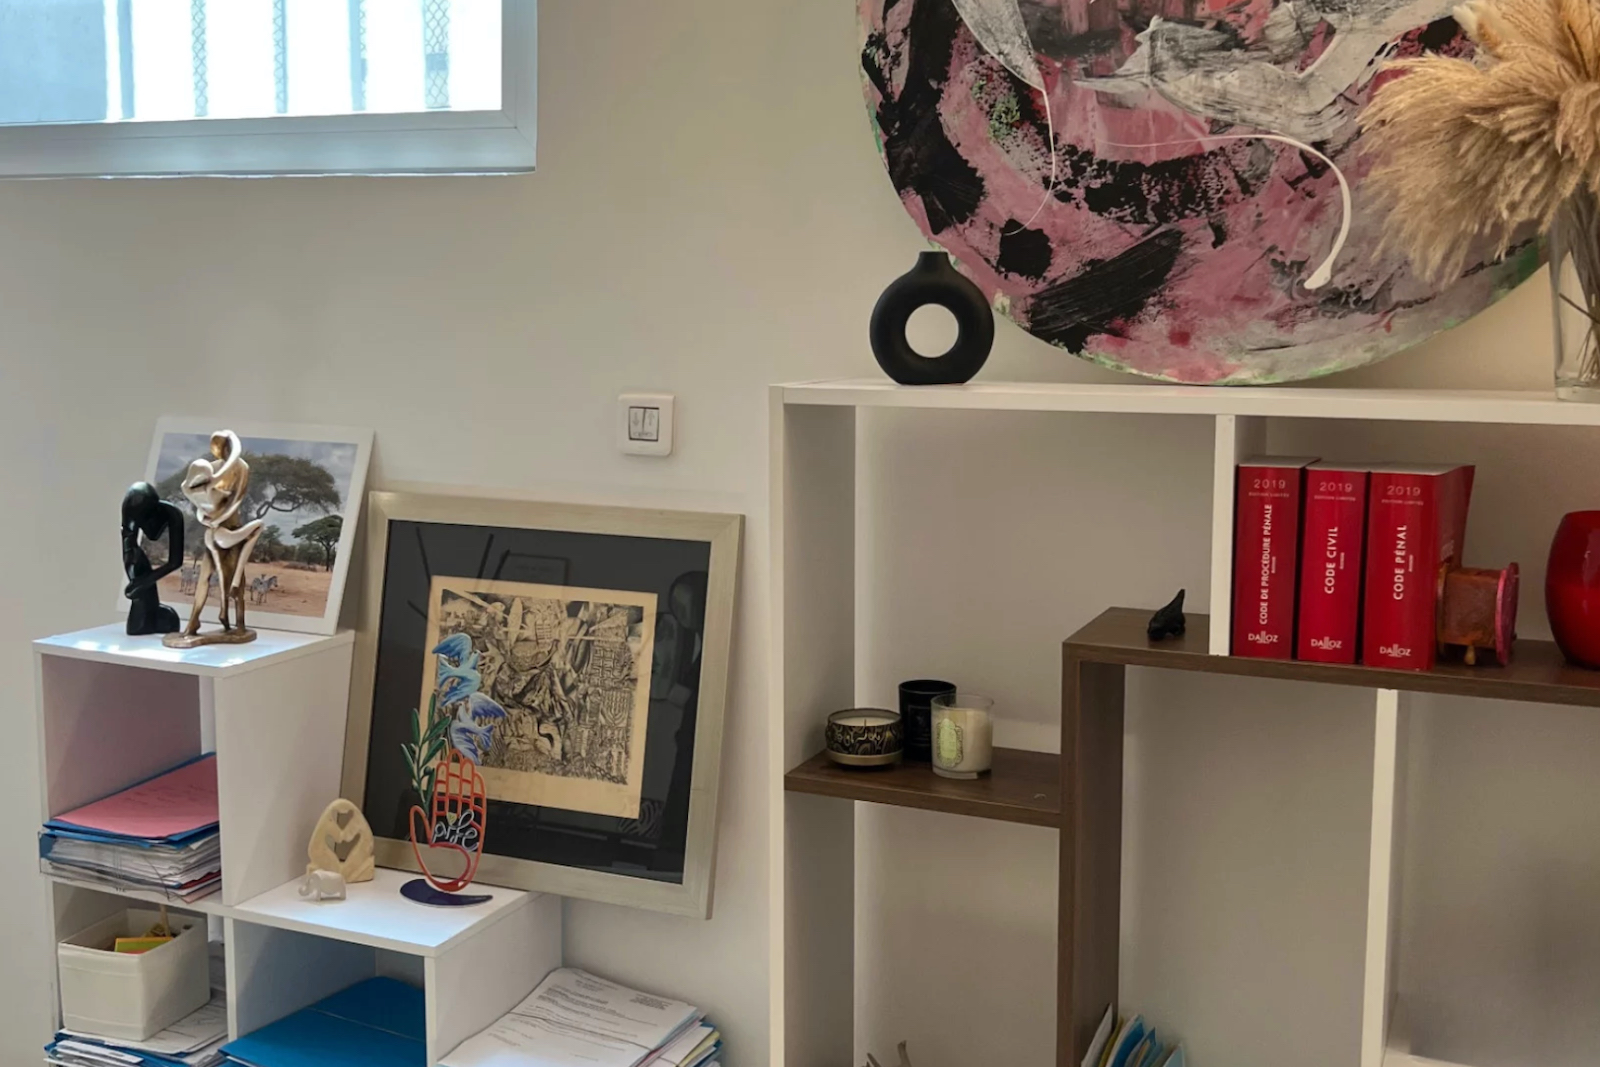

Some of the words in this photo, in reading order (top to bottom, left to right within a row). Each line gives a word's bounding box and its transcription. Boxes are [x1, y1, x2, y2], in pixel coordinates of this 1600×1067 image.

[1253, 479, 1286, 489] 2019
[1319, 481, 1353, 493] 2019
[1387, 485, 1421, 496] 2019
[1262, 504, 1273, 536] PÉNALE
[1326, 526, 1338, 559] CIVIL
[1393, 524, 1407, 564] PÉNAL
[1261, 537, 1271, 587] PROCÉDURE
[1324, 562, 1336, 594] CODE
[1260, 588, 1269, 600] DE
[1392, 568, 1405, 600] CODE
[1259, 601, 1269, 625] CODE
